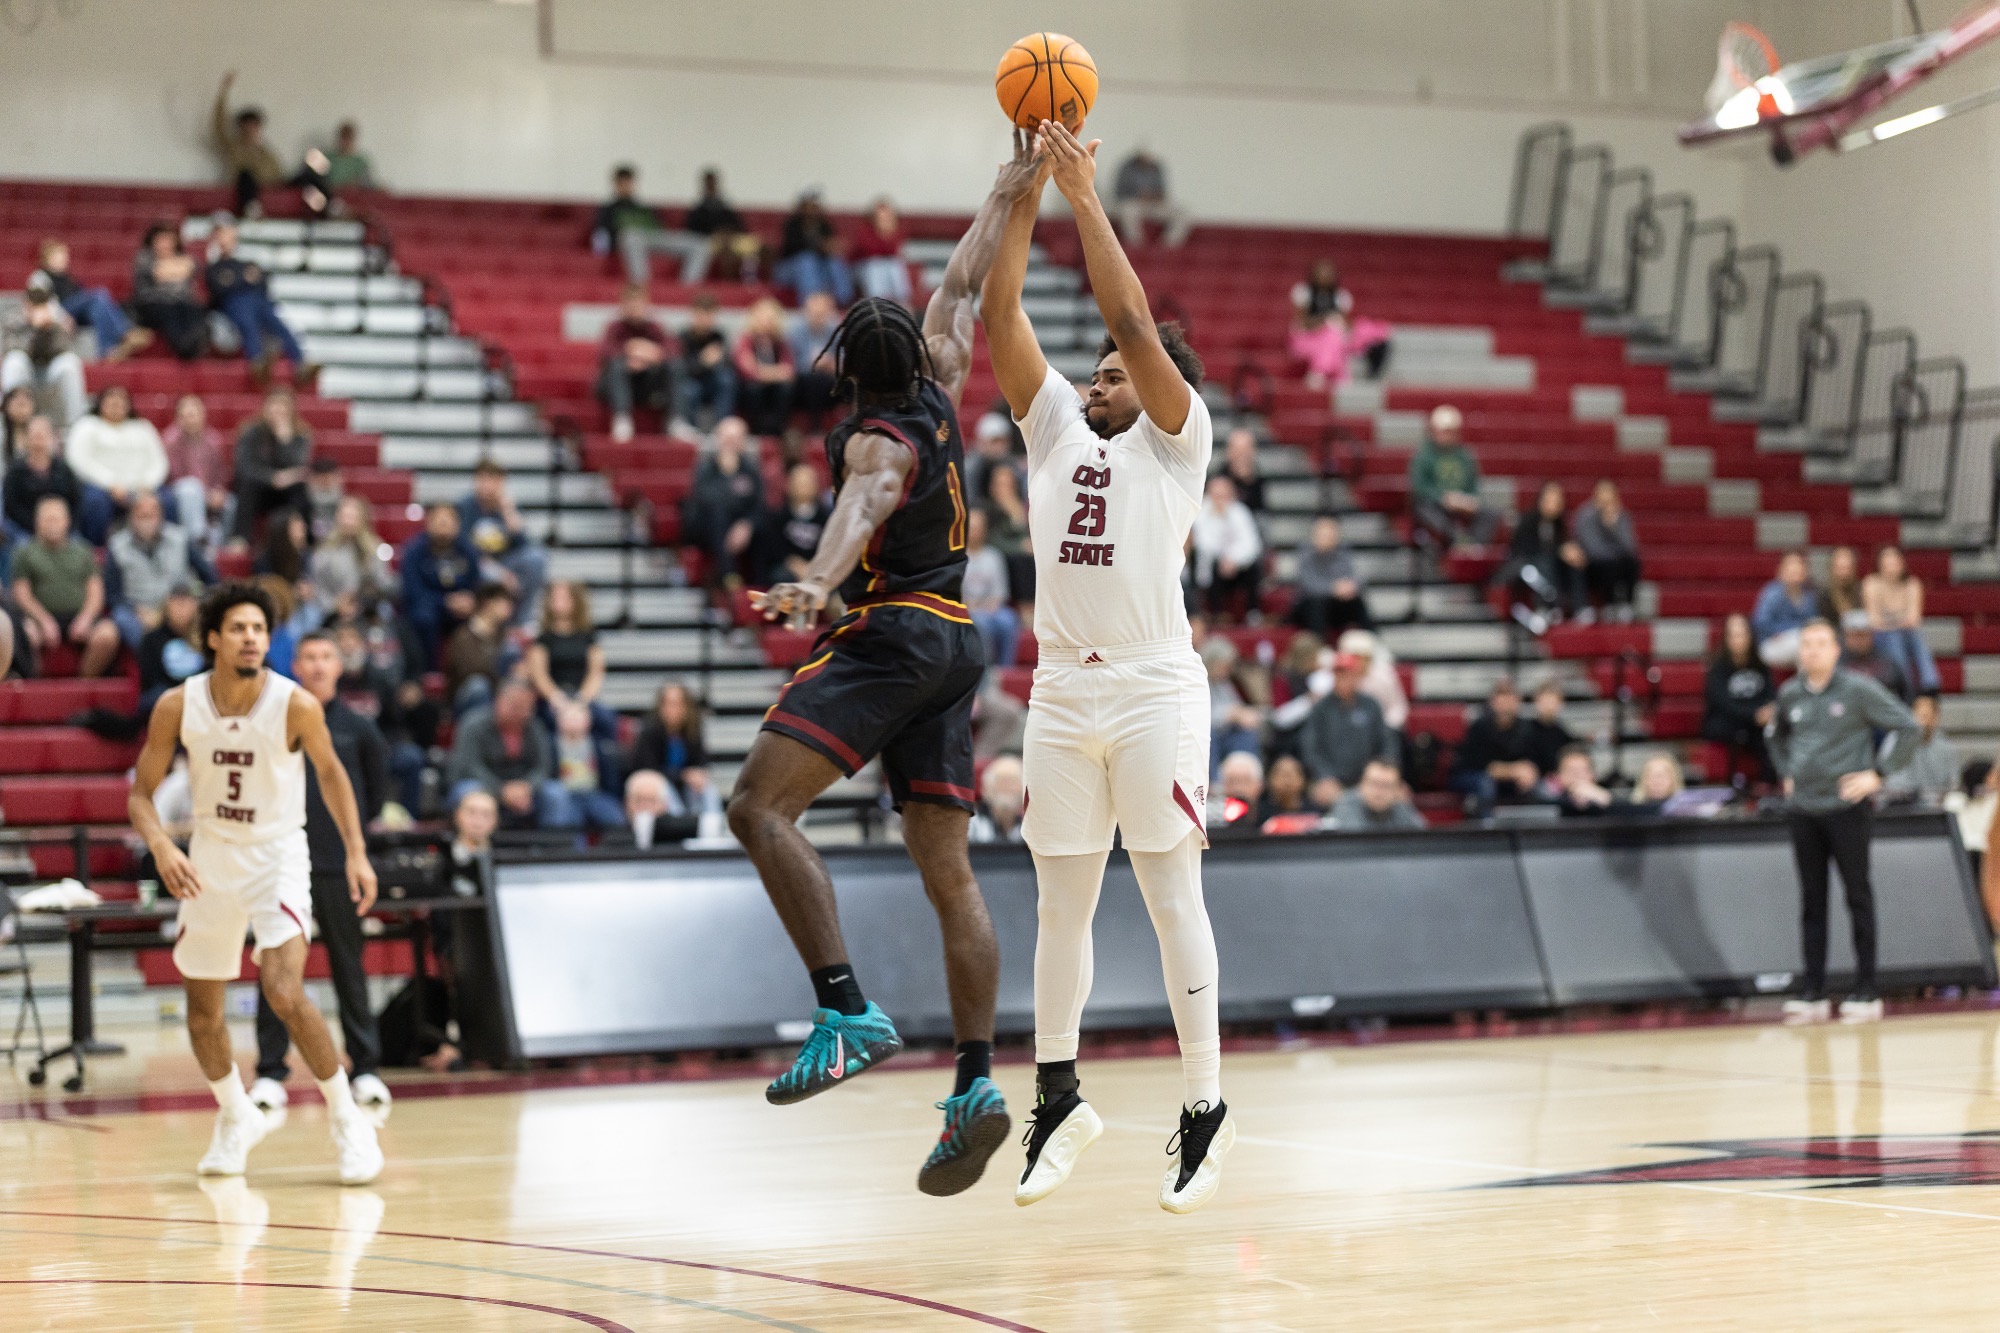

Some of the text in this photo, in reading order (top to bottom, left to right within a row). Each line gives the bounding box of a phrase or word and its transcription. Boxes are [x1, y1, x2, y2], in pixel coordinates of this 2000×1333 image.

[946, 461, 967, 551] 1
[1067, 492, 1106, 537] 23
[1058, 541, 1115, 566] STATE
[227, 770, 242, 801] 5
[216, 804, 255, 823] STATE
